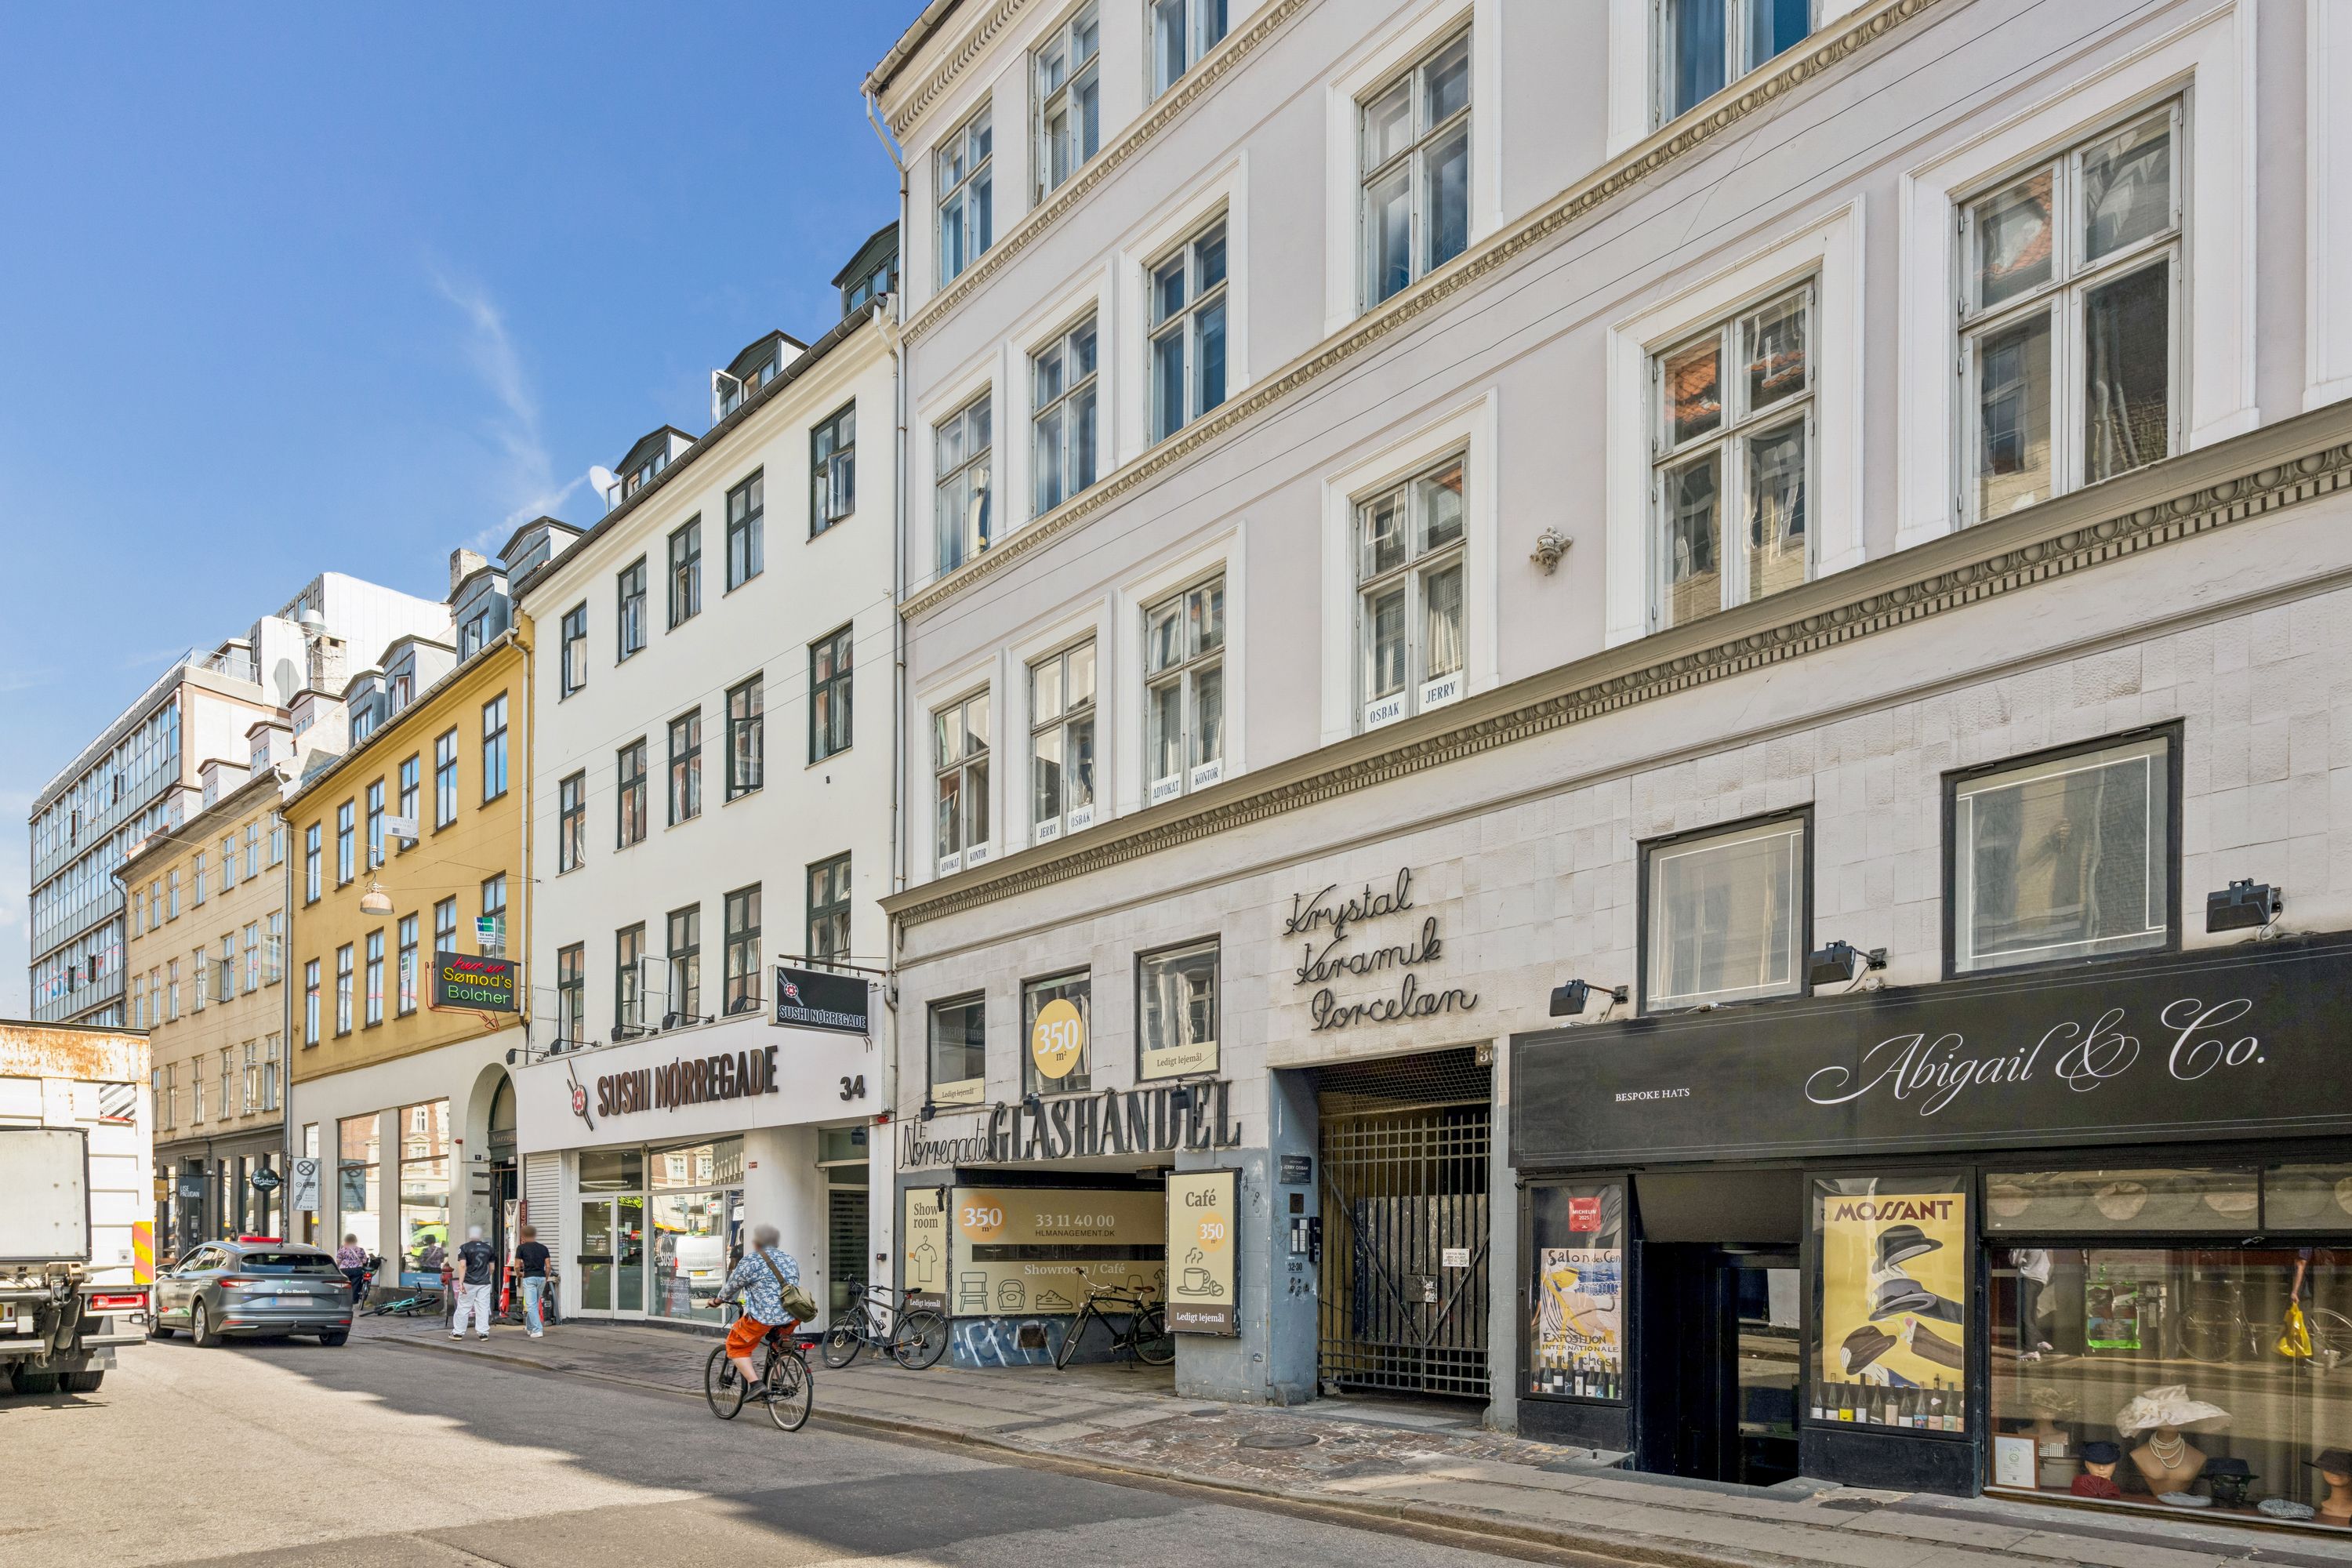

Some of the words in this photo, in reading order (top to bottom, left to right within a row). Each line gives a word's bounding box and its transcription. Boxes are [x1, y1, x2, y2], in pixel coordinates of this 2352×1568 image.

[1425, 681, 1456, 704] JERRY
[1370, 702, 1399, 724] OSBAK
[1195, 767, 1218, 786] KONTOR
[1152, 780, 1179, 799] ADVOKAT
[1071, 811, 1091, 828] OSBAK
[1040, 822, 1057, 838] JERRY
[969, 848, 987, 862] KONTOR
[941, 857, 960, 873] ADVOKAT
[1283, 866, 1414, 938] Krystal
[1293, 916, 1442, 985] Keramik
[452, 956, 484, 972] her
[443, 967, 512, 989] Sømod's
[448, 985, 510, 1004] Bolcher
[779, 1004, 809, 1022] SUSHI
[810, 1008, 866, 1029] NØRREGADE
[1037, 1019, 1079, 1054] 350
[1156, 1056, 1176, 1068] Ledigt
[1178, 1052, 1202, 1066] lejemål
[1805, 1022, 2080, 1116] Abigail
[2055, 1008, 2140, 1092] &
[2161, 998, 2265, 1080] Co.
[597, 1068, 651, 1117] SUSHI
[655, 1045, 779, 1113] NØRREGADE
[839, 1075, 866, 1102] 34
[942, 1089, 956, 1100] Ledigt
[958, 1087, 975, 1099] lejemål
[1615, 1090, 1660, 1102] BESPOKE
[1661, 1087, 1690, 1098] HATS
[988, 1080, 1241, 1163] GLASHANDEL
[252, 1176, 278, 1185] Carlsberg
[1185, 1189, 1217, 1207] Café
[913, 1202, 938, 1216] Show
[964, 1207, 1003, 1227] 350
[1834, 1200, 1954, 1221] MOSSANT
[913, 1216, 938, 1229] room
[1035, 1214, 1053, 1227] 33
[1057, 1214, 1070, 1227] 11
[1074, 1214, 1092, 1227] 40
[1096, 1214, 1116, 1227] 00
[1200, 1223, 1225, 1240] 350
[1548, 1249, 1590, 1266] Salon
[1100, 1262, 1126, 1275] Café
[1288, 1262, 1303, 1272] 32-30
[909, 1298, 924, 1307] Ledigt
[924, 1298, 941, 1308] lejemål
[1176, 1312, 1197, 1323] Ledigt
[1199, 1312, 1225, 1323] lejemål
[1543, 1333, 1606, 1345] EXPOSITION
[1542, 1345, 1619, 1353] INTERNATIONALE
